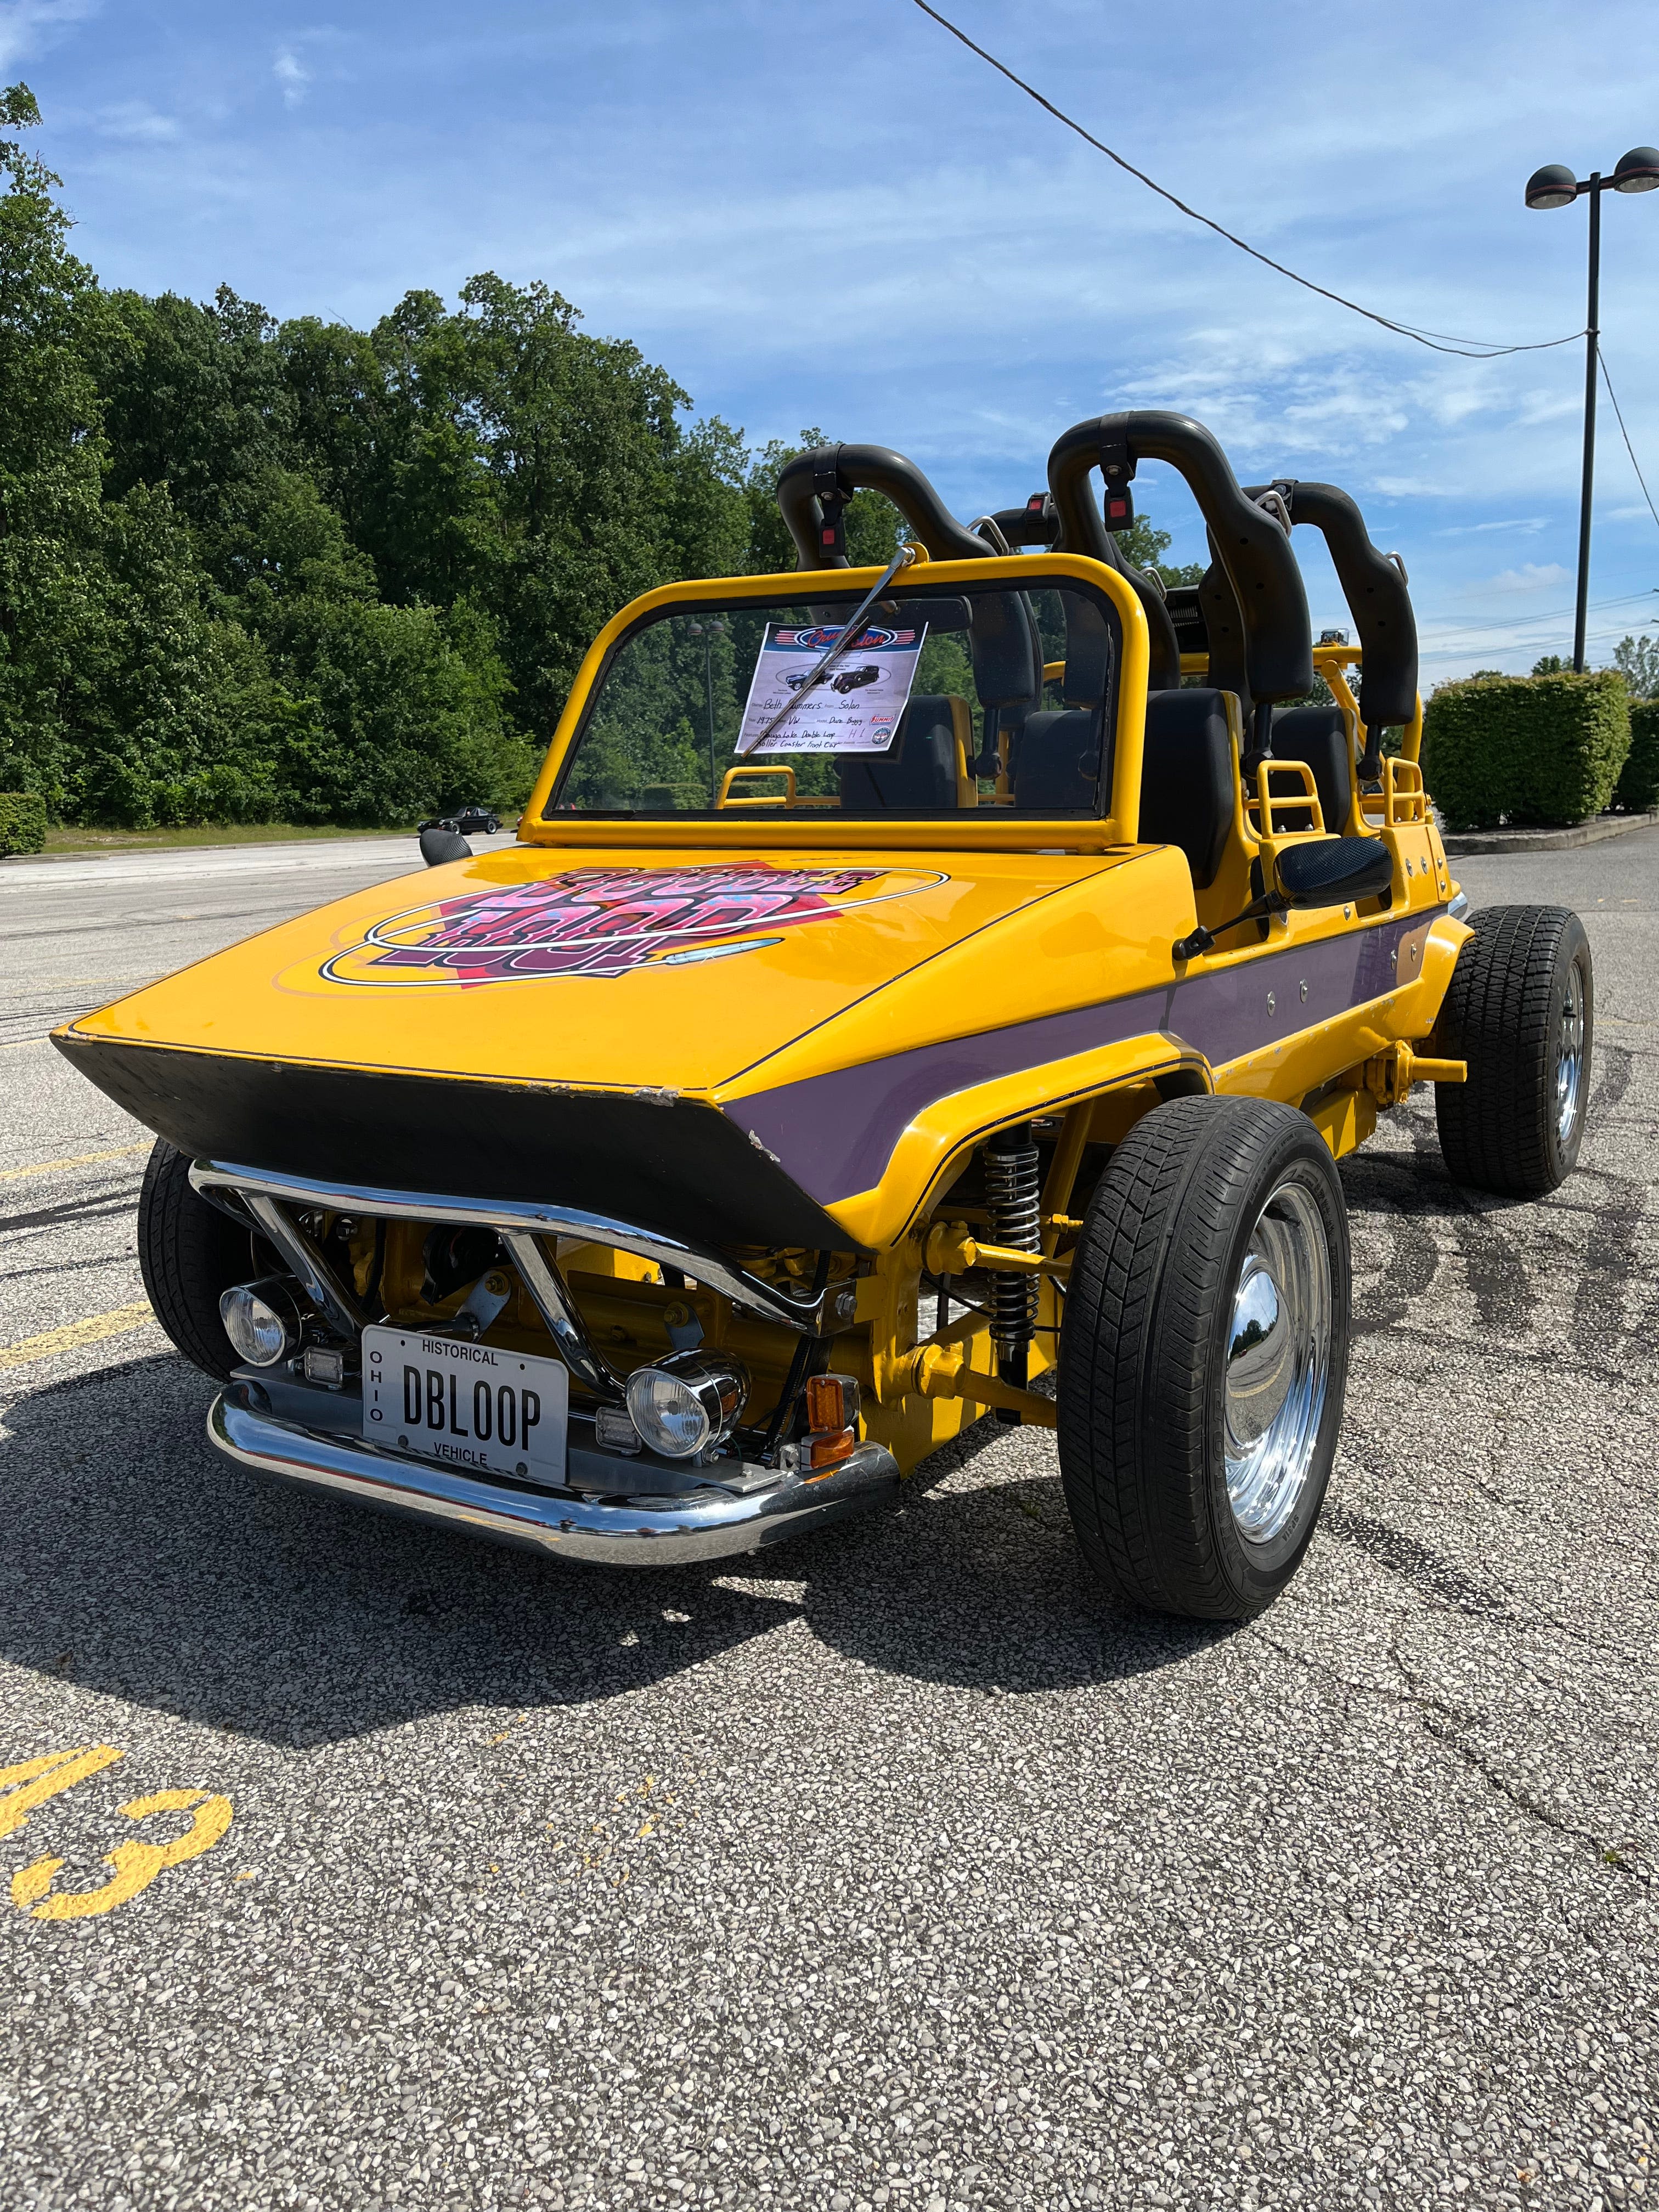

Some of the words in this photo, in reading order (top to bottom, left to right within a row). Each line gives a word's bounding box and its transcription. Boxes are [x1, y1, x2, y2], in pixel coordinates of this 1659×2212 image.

[763, 698, 782, 710] Beth
[462, 867, 892, 910] DOUBLE
[422, 1339, 498, 1366] HISTORICAL
[369, 1351, 383, 1421] OHIO
[403, 1364, 540, 1451] DBLOOP
[433, 1442, 487, 1466] VEHICLE
